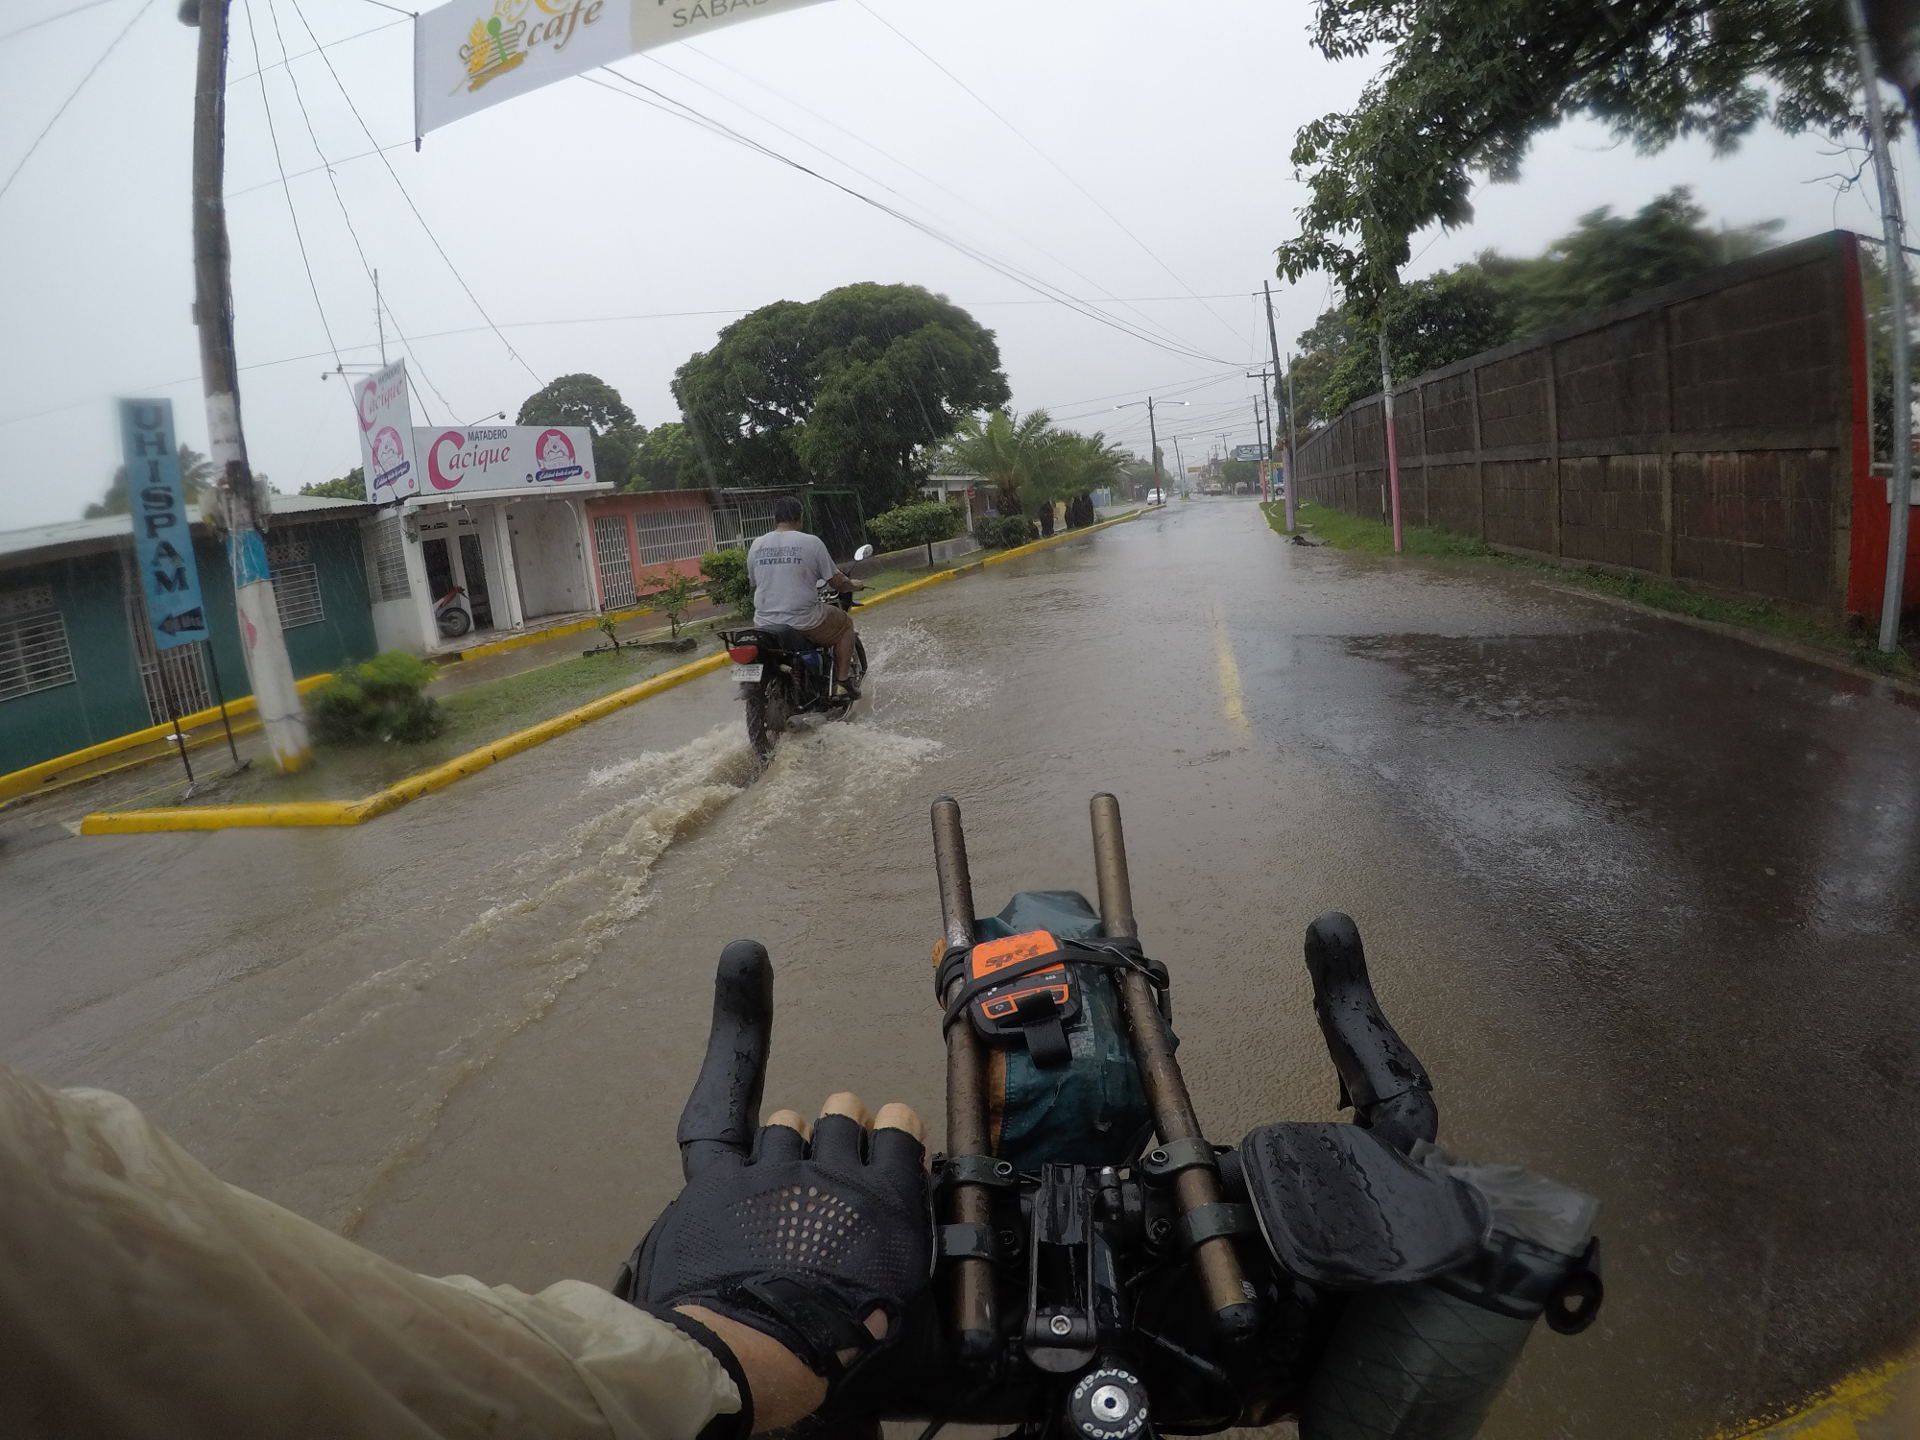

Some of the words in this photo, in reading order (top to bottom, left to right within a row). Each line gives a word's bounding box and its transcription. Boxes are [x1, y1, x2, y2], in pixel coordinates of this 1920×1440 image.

[359, 380, 403, 432] Cacique
[428, 431, 511, 490] Cacique
[467, 428, 508, 442] MATADERO
